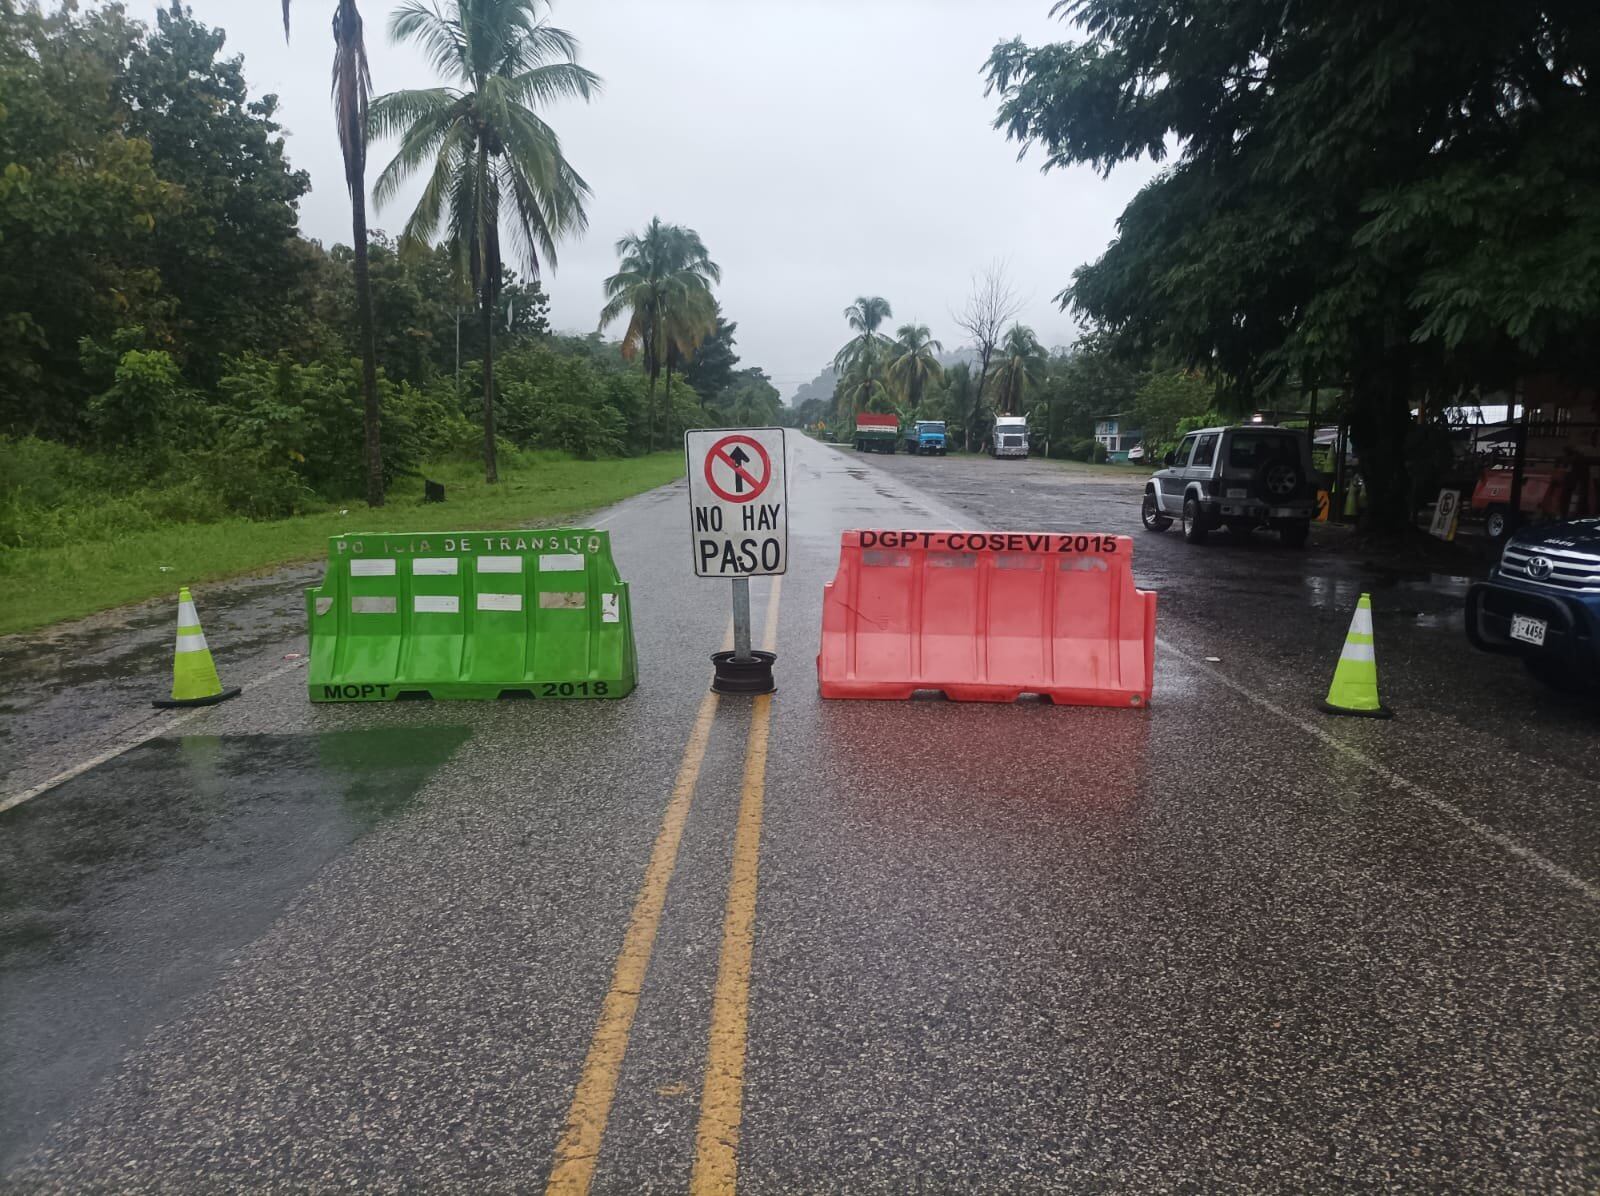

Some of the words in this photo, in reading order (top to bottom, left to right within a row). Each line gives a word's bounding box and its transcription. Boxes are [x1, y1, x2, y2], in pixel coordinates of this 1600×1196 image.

[695, 505, 723, 532] NO
[742, 503, 780, 531] HAY
[445, 538, 471, 552] DE
[484, 535, 601, 554] TRANSITO
[860, 530, 1050, 552] DGPT-COSEVI
[1058, 535, 1117, 553] 2015
[699, 537, 780, 573] PASO
[323, 684, 390, 699] MOPT
[541, 681, 609, 697] 2018
